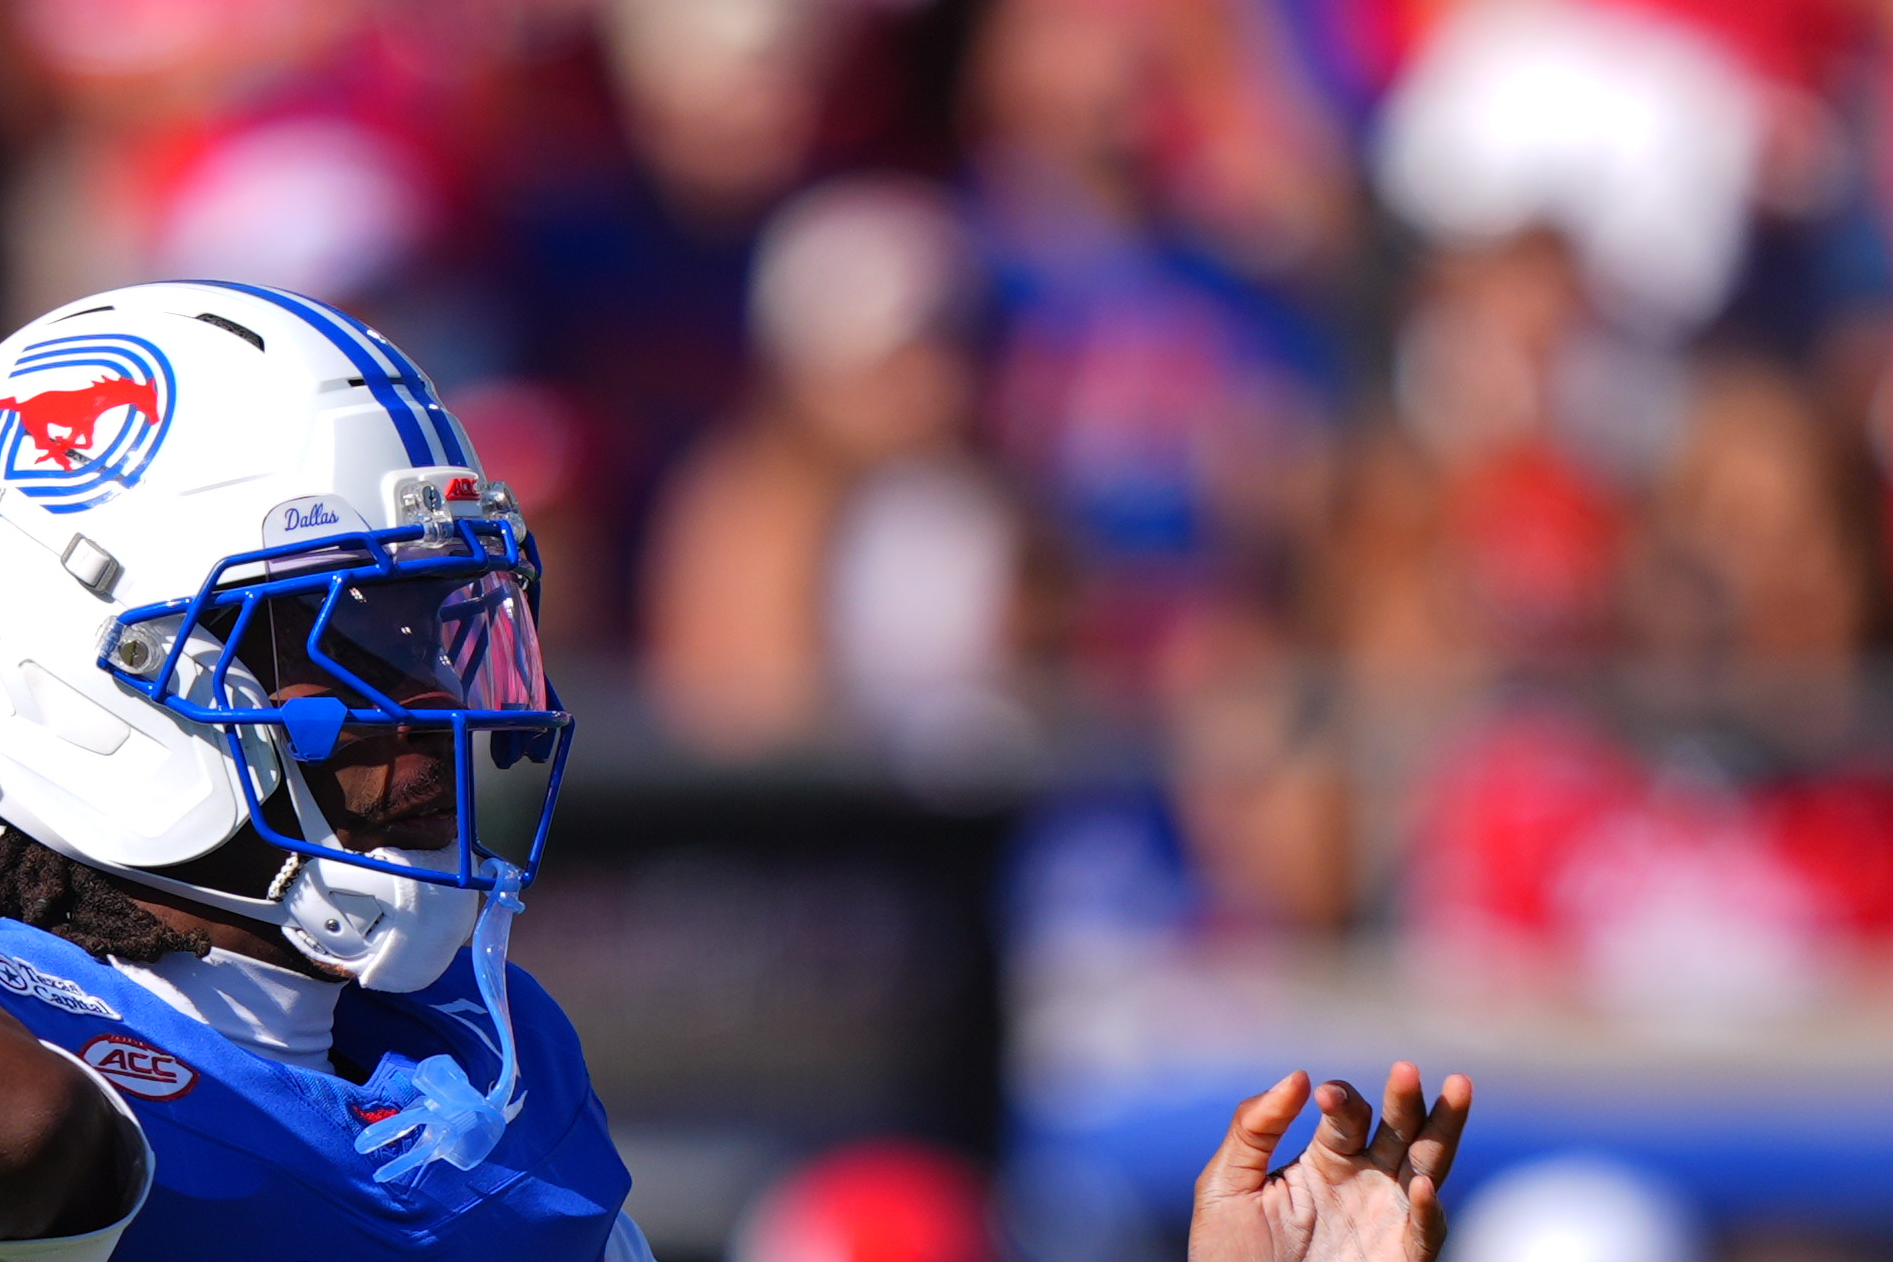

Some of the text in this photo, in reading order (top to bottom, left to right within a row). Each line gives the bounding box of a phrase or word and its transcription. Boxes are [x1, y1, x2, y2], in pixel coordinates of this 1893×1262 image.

[284, 503, 340, 532] Dallas
[18, 963, 83, 996] Texas
[33, 985, 114, 1016] Capital
[98, 1049, 177, 1078] ACC
